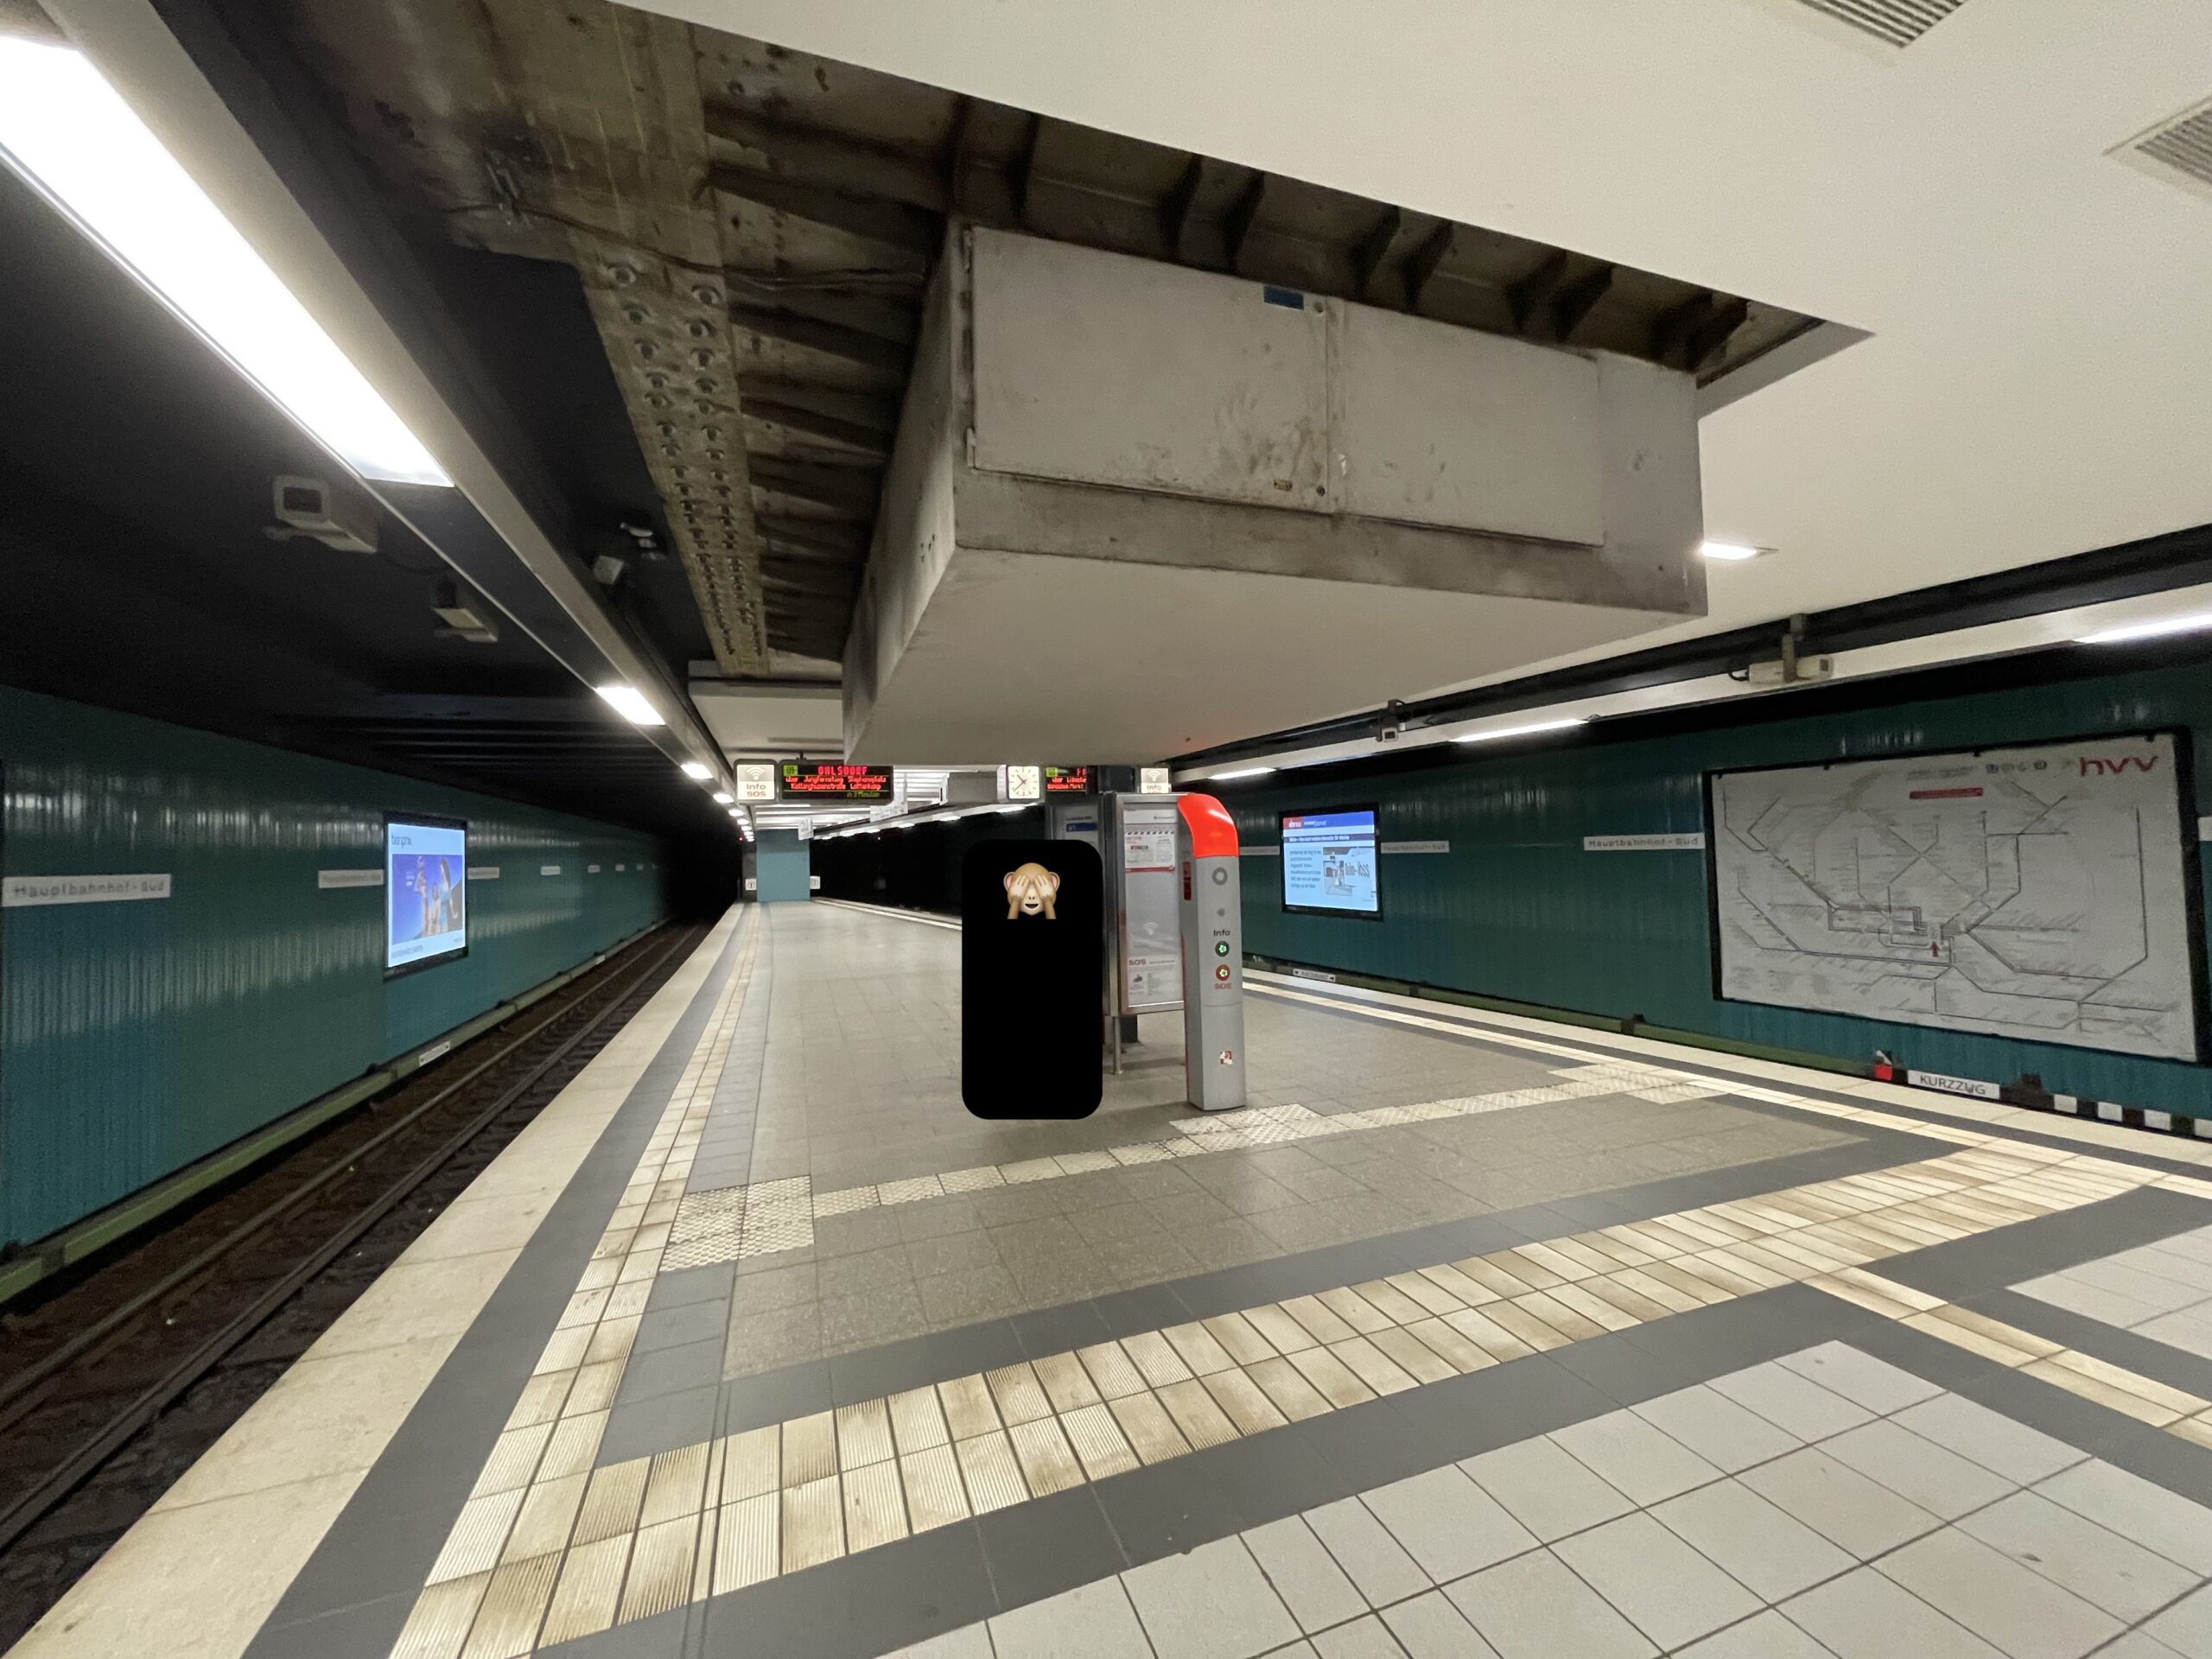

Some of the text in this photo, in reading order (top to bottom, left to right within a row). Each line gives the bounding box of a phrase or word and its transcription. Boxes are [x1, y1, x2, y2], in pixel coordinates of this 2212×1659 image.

[817, 766, 868, 775] OHLSDORF
[2080, 756, 2158, 776] hvv
[1920, 1074, 1986, 1095] KURZZUG
